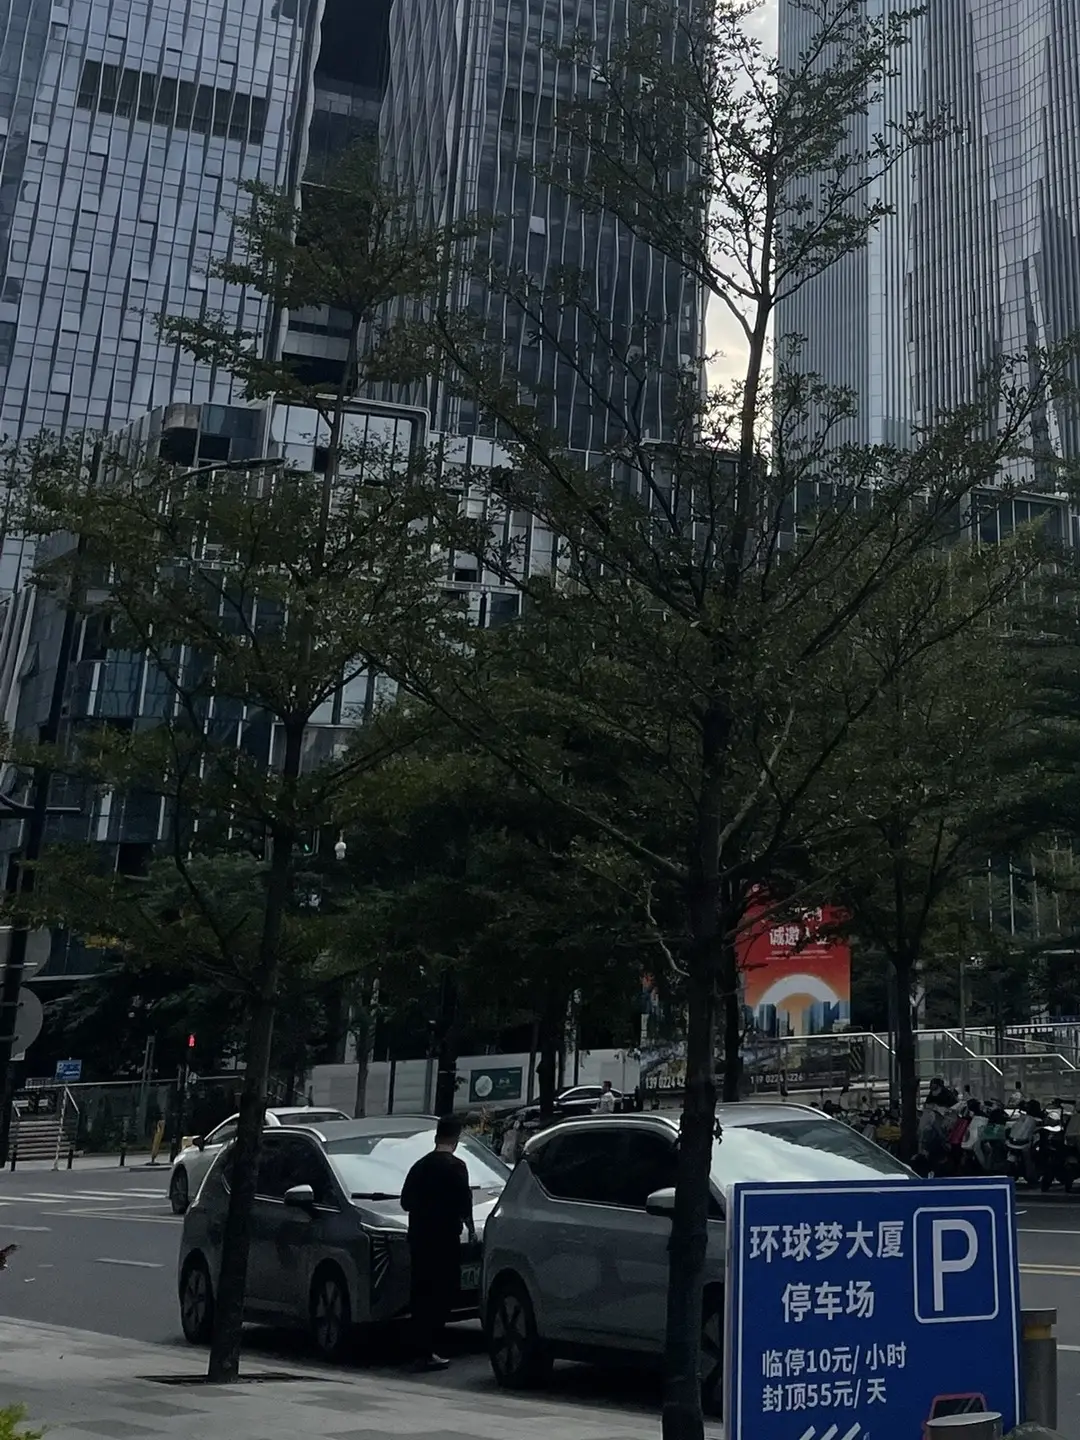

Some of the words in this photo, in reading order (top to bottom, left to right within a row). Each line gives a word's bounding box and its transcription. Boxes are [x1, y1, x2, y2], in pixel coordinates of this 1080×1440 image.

[749, 1220, 905, 1262] 环球梦大厦
[932, 1218, 979, 1311] P
[781, 1280, 875, 1323] 停车场
